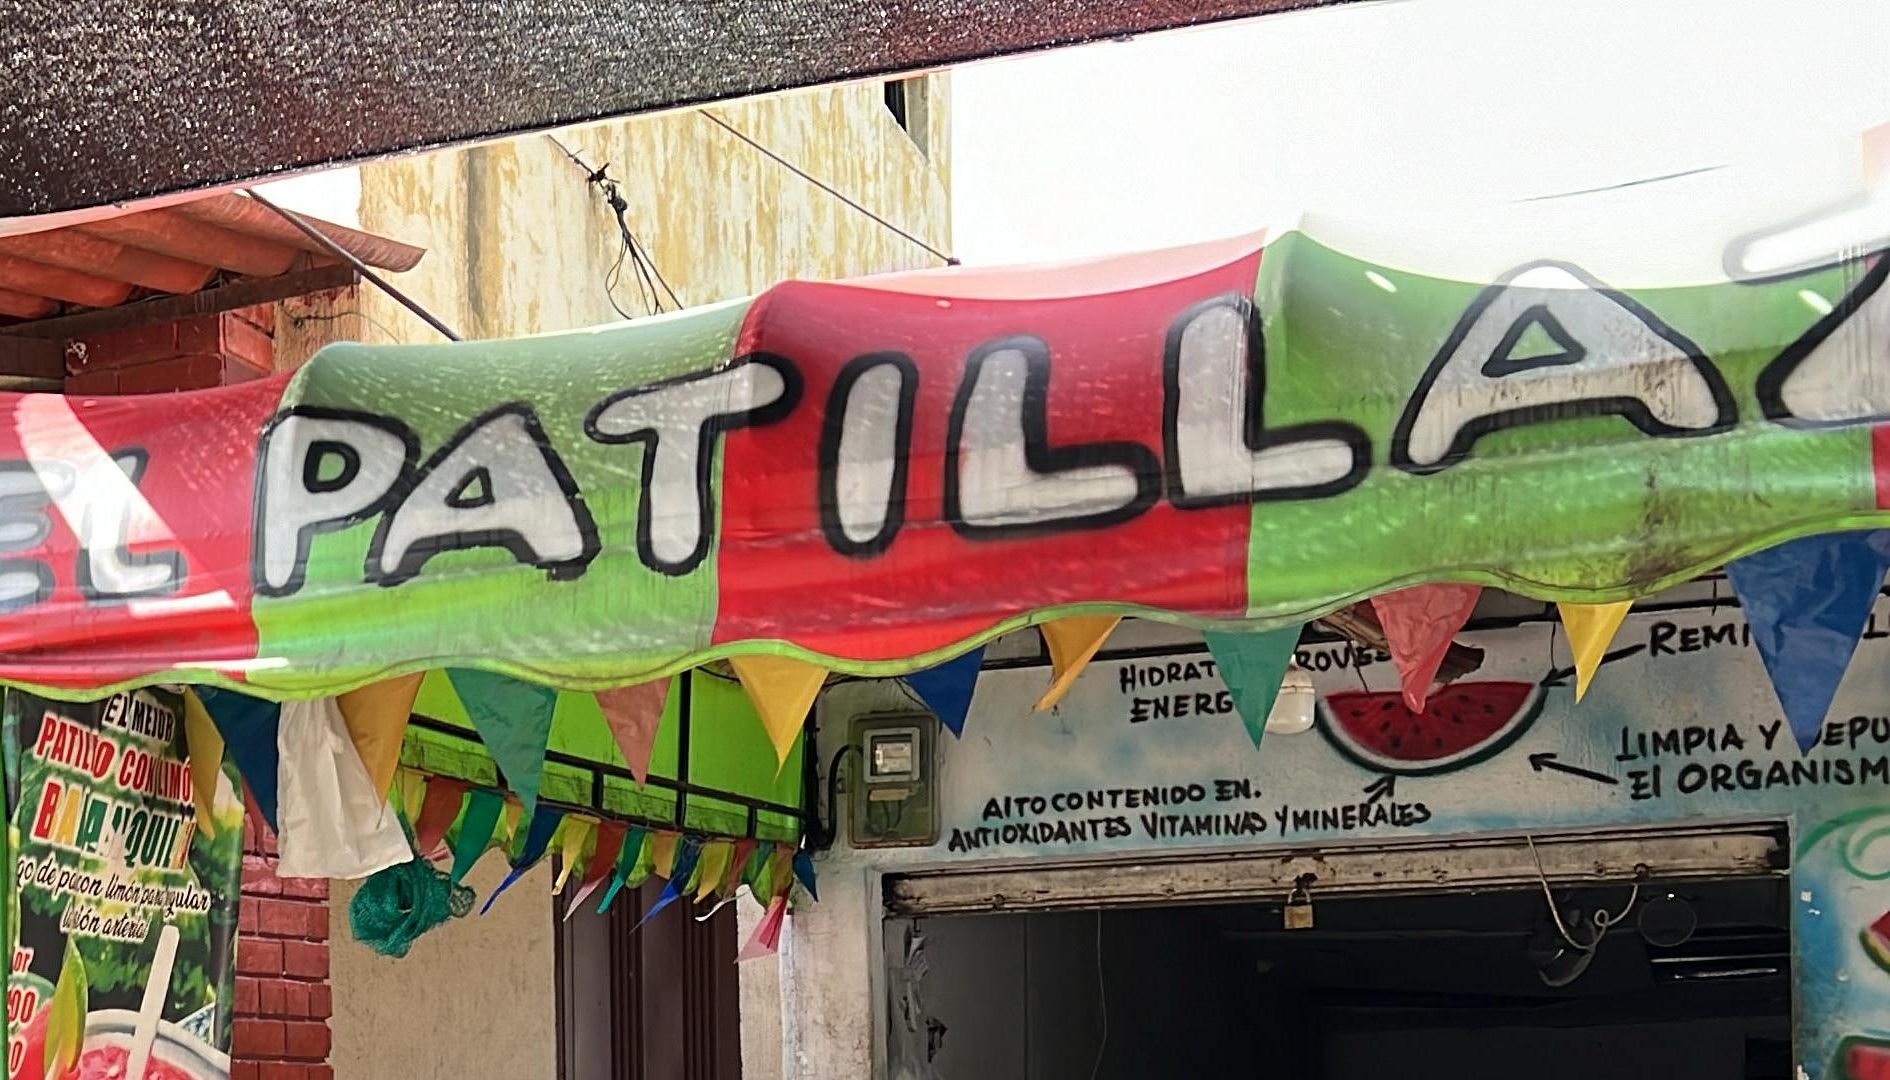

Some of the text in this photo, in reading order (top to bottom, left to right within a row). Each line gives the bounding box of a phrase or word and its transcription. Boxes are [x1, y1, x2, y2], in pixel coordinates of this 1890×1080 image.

[252, 190, 1890, 598] PATILLAZ
[1120, 659, 1216, 694] HIDRAT
[131, 699, 174, 743] MEJOR
[1130, 691, 1234, 723] ENERG
[1616, 723, 1745, 762] LIMPIA
[1759, 719, 1782, 750] Y
[157, 757, 192, 802] LIMÓ
[1677, 755, 1890, 794] ORGANISM
[1051, 783, 1206, 813] CONTENIDO
[948, 815, 1132, 854] ANTIOXIDANTES
[1141, 805, 1267, 840] VITAMINAS
[1293, 802, 1432, 836] MINERALES
